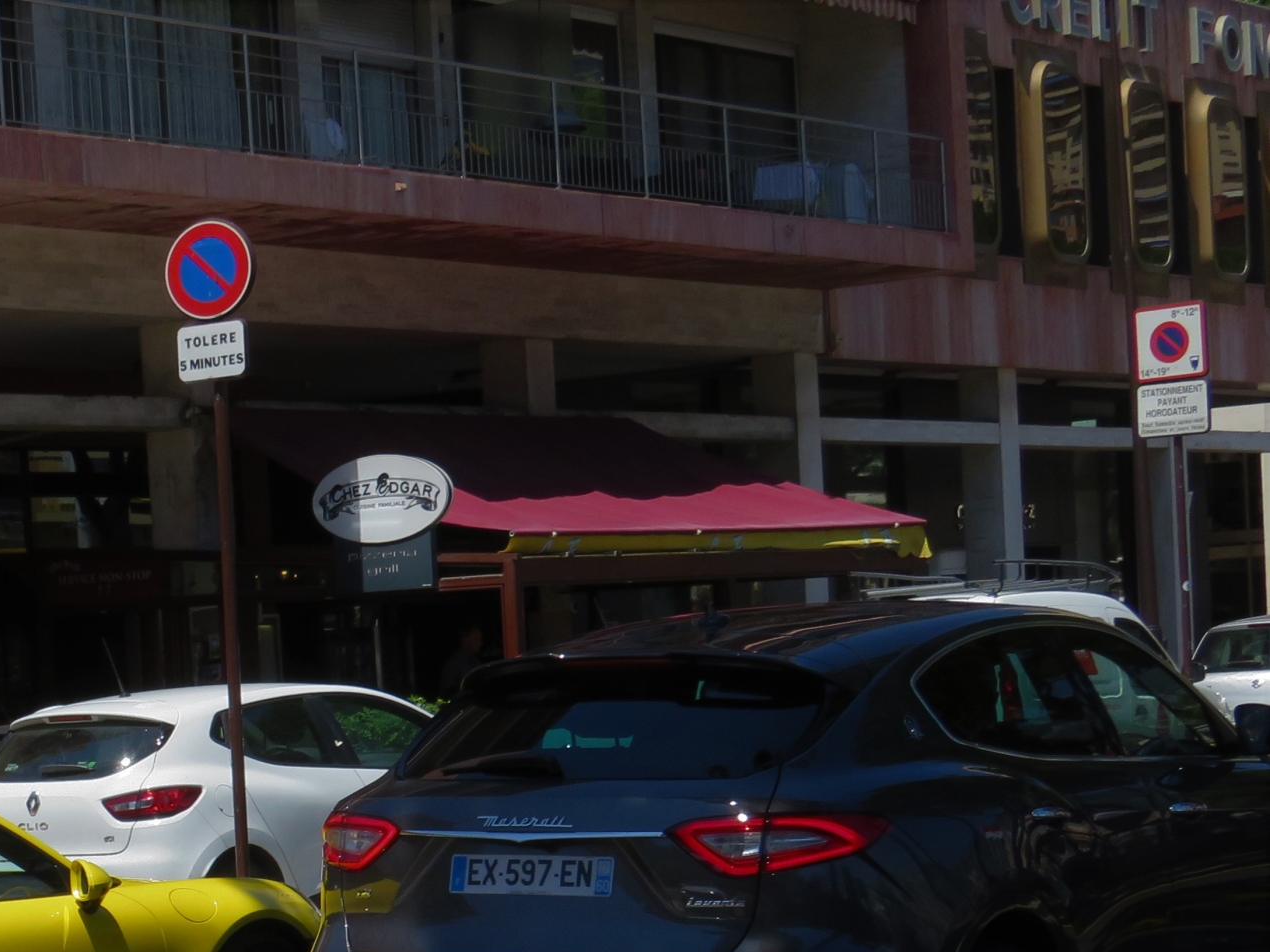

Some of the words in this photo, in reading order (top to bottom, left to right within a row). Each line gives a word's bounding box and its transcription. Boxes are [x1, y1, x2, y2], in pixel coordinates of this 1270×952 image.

[1189, 6, 1270, 80] FON
[184, 332, 237, 349] TOLERE
[180, 360, 187, 372] 5
[189, 353, 244, 371] MINUTES
[1141, 384, 1203, 398] STATIONNEMENT
[1157, 396, 1187, 406] PAYANT
[1146, 406, 1198, 418] HORODATEUR
[329, 484, 372, 504] CHEZ
[376, 473, 433, 498] EDGAR
[353, 502, 376, 510] CUISINE
[378, 500, 406, 508] FAMILIALE
[18, 822, 49, 831] CLIO
[477, 815, 573, 828] Maserati
[468, 859, 593, 887] EX-597-EN
[596, 879, 609, 892] 60
